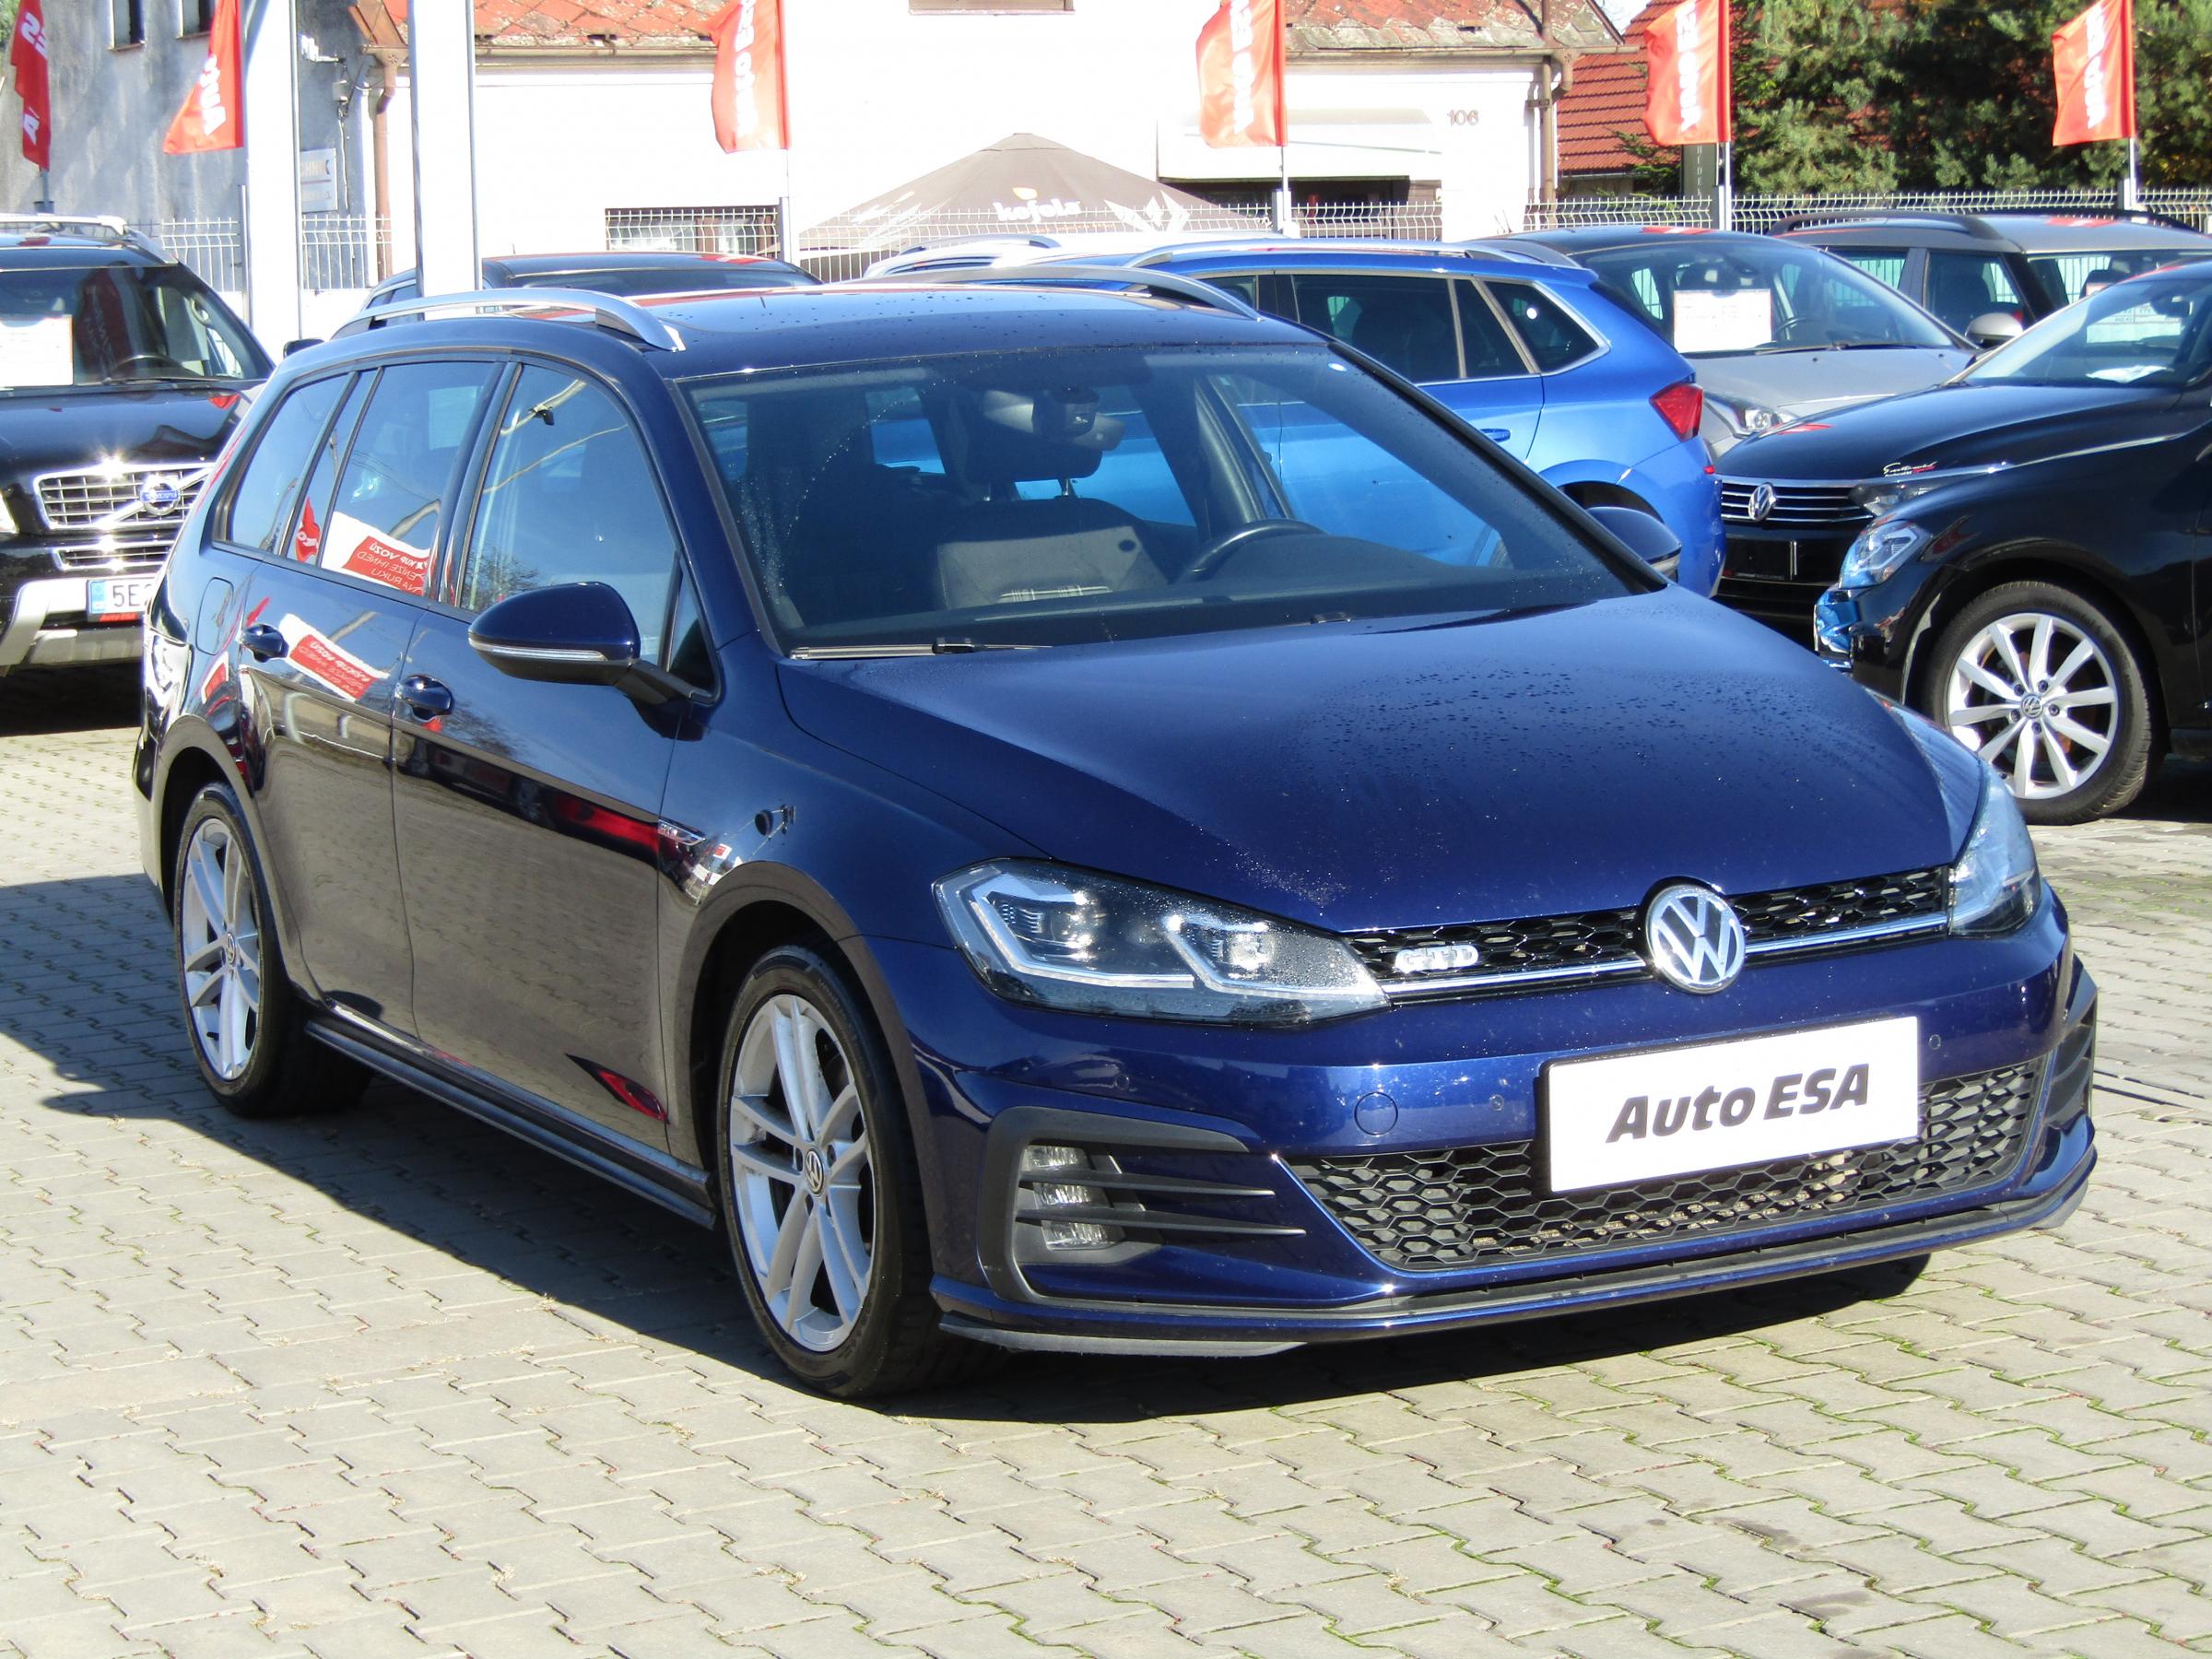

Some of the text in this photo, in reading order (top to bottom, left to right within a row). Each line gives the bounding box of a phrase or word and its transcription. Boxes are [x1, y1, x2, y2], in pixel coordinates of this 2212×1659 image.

[1447, 109, 1479, 126] 106
[1395, 944, 1478, 973] GTD
[1605, 1062, 1870, 1144] Auto ESA
